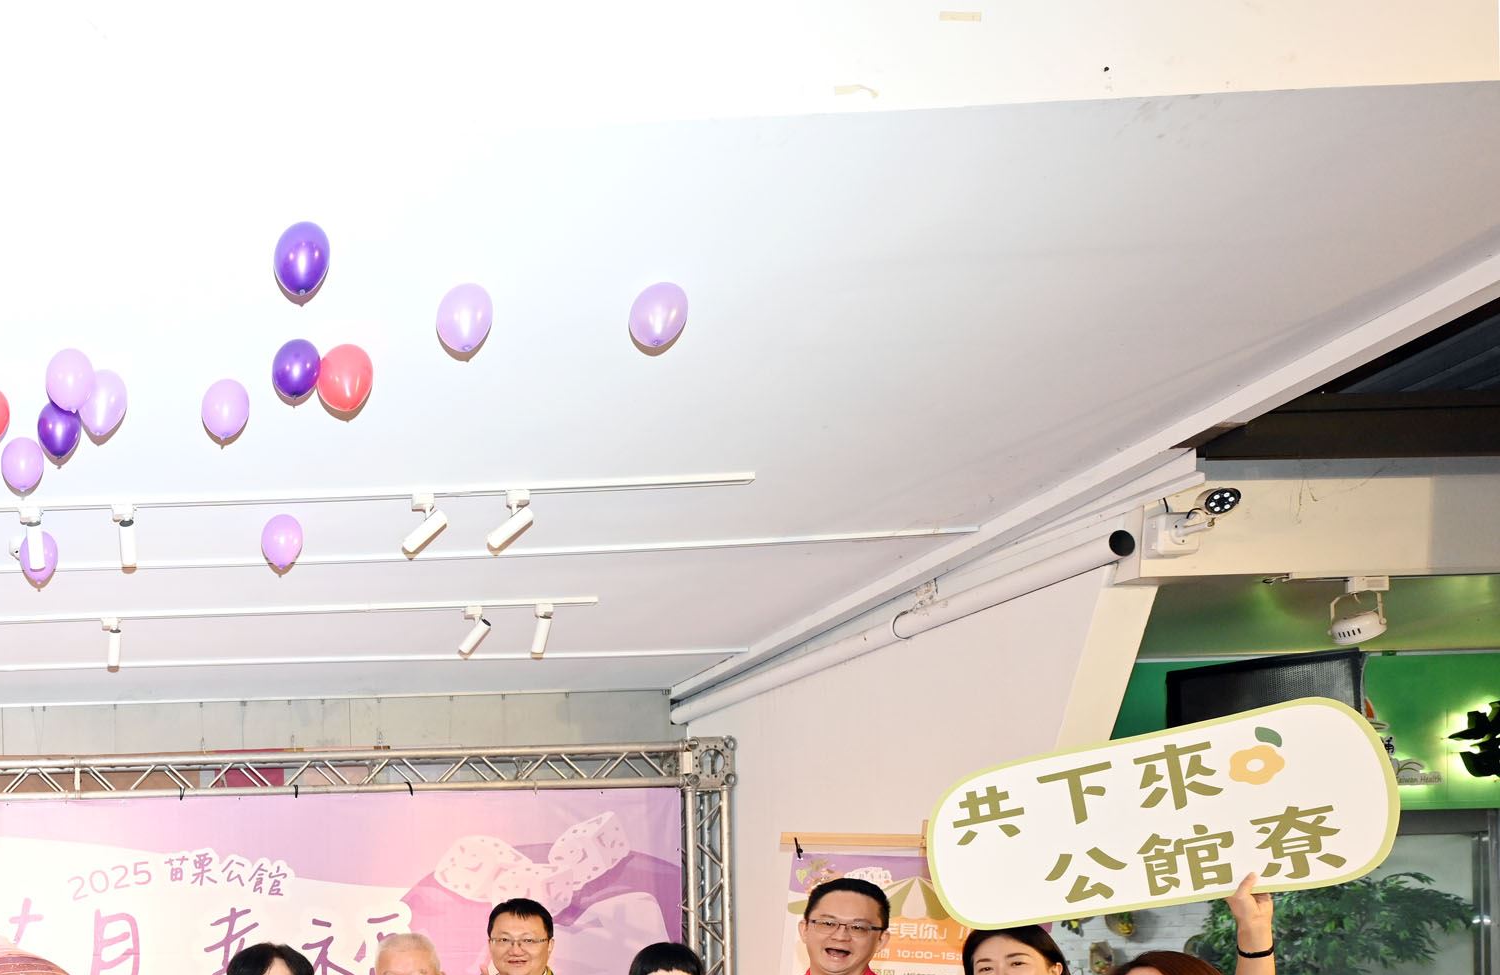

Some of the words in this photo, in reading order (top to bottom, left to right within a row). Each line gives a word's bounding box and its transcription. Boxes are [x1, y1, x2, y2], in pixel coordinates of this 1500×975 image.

[952, 741, 1224, 846] 共下來
[1396, 774, 1418, 783] aiwan
[67, 861, 152, 900] 2025
[163, 853, 289, 897] 苗栗公館
